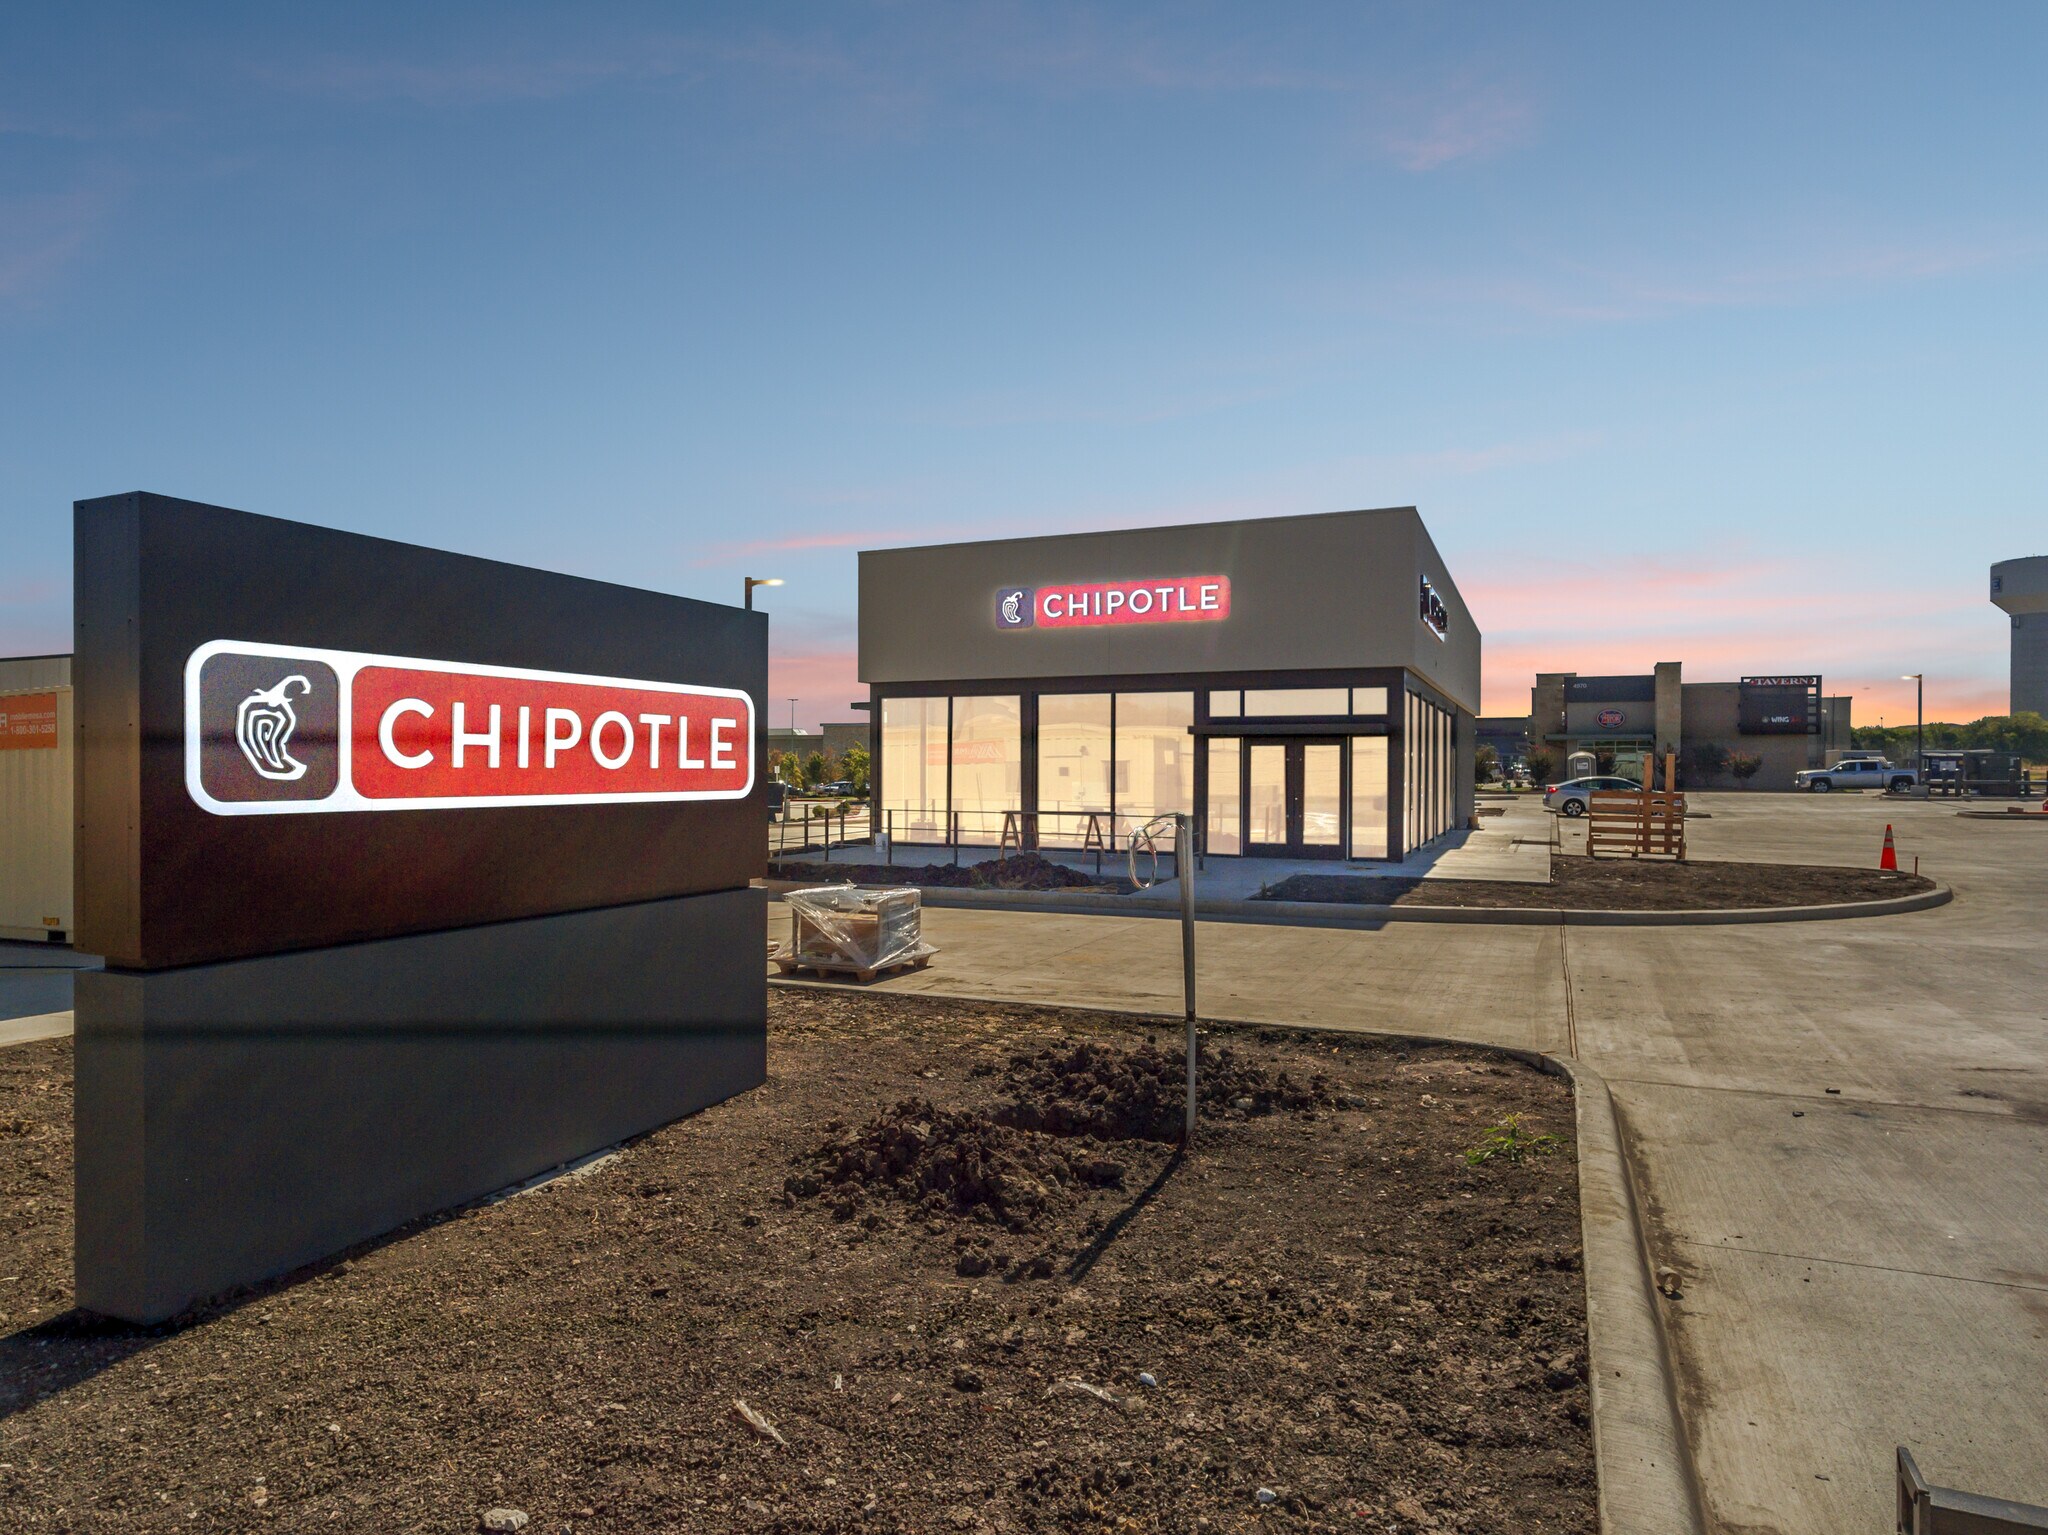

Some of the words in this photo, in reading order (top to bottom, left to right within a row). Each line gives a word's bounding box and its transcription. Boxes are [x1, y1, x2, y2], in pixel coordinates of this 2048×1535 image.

[1043, 584, 1219, 618] CHIPOTLE
[1754, 677, 1809, 686] TAVERN
[378, 697, 738, 770] CHIPOTLE
